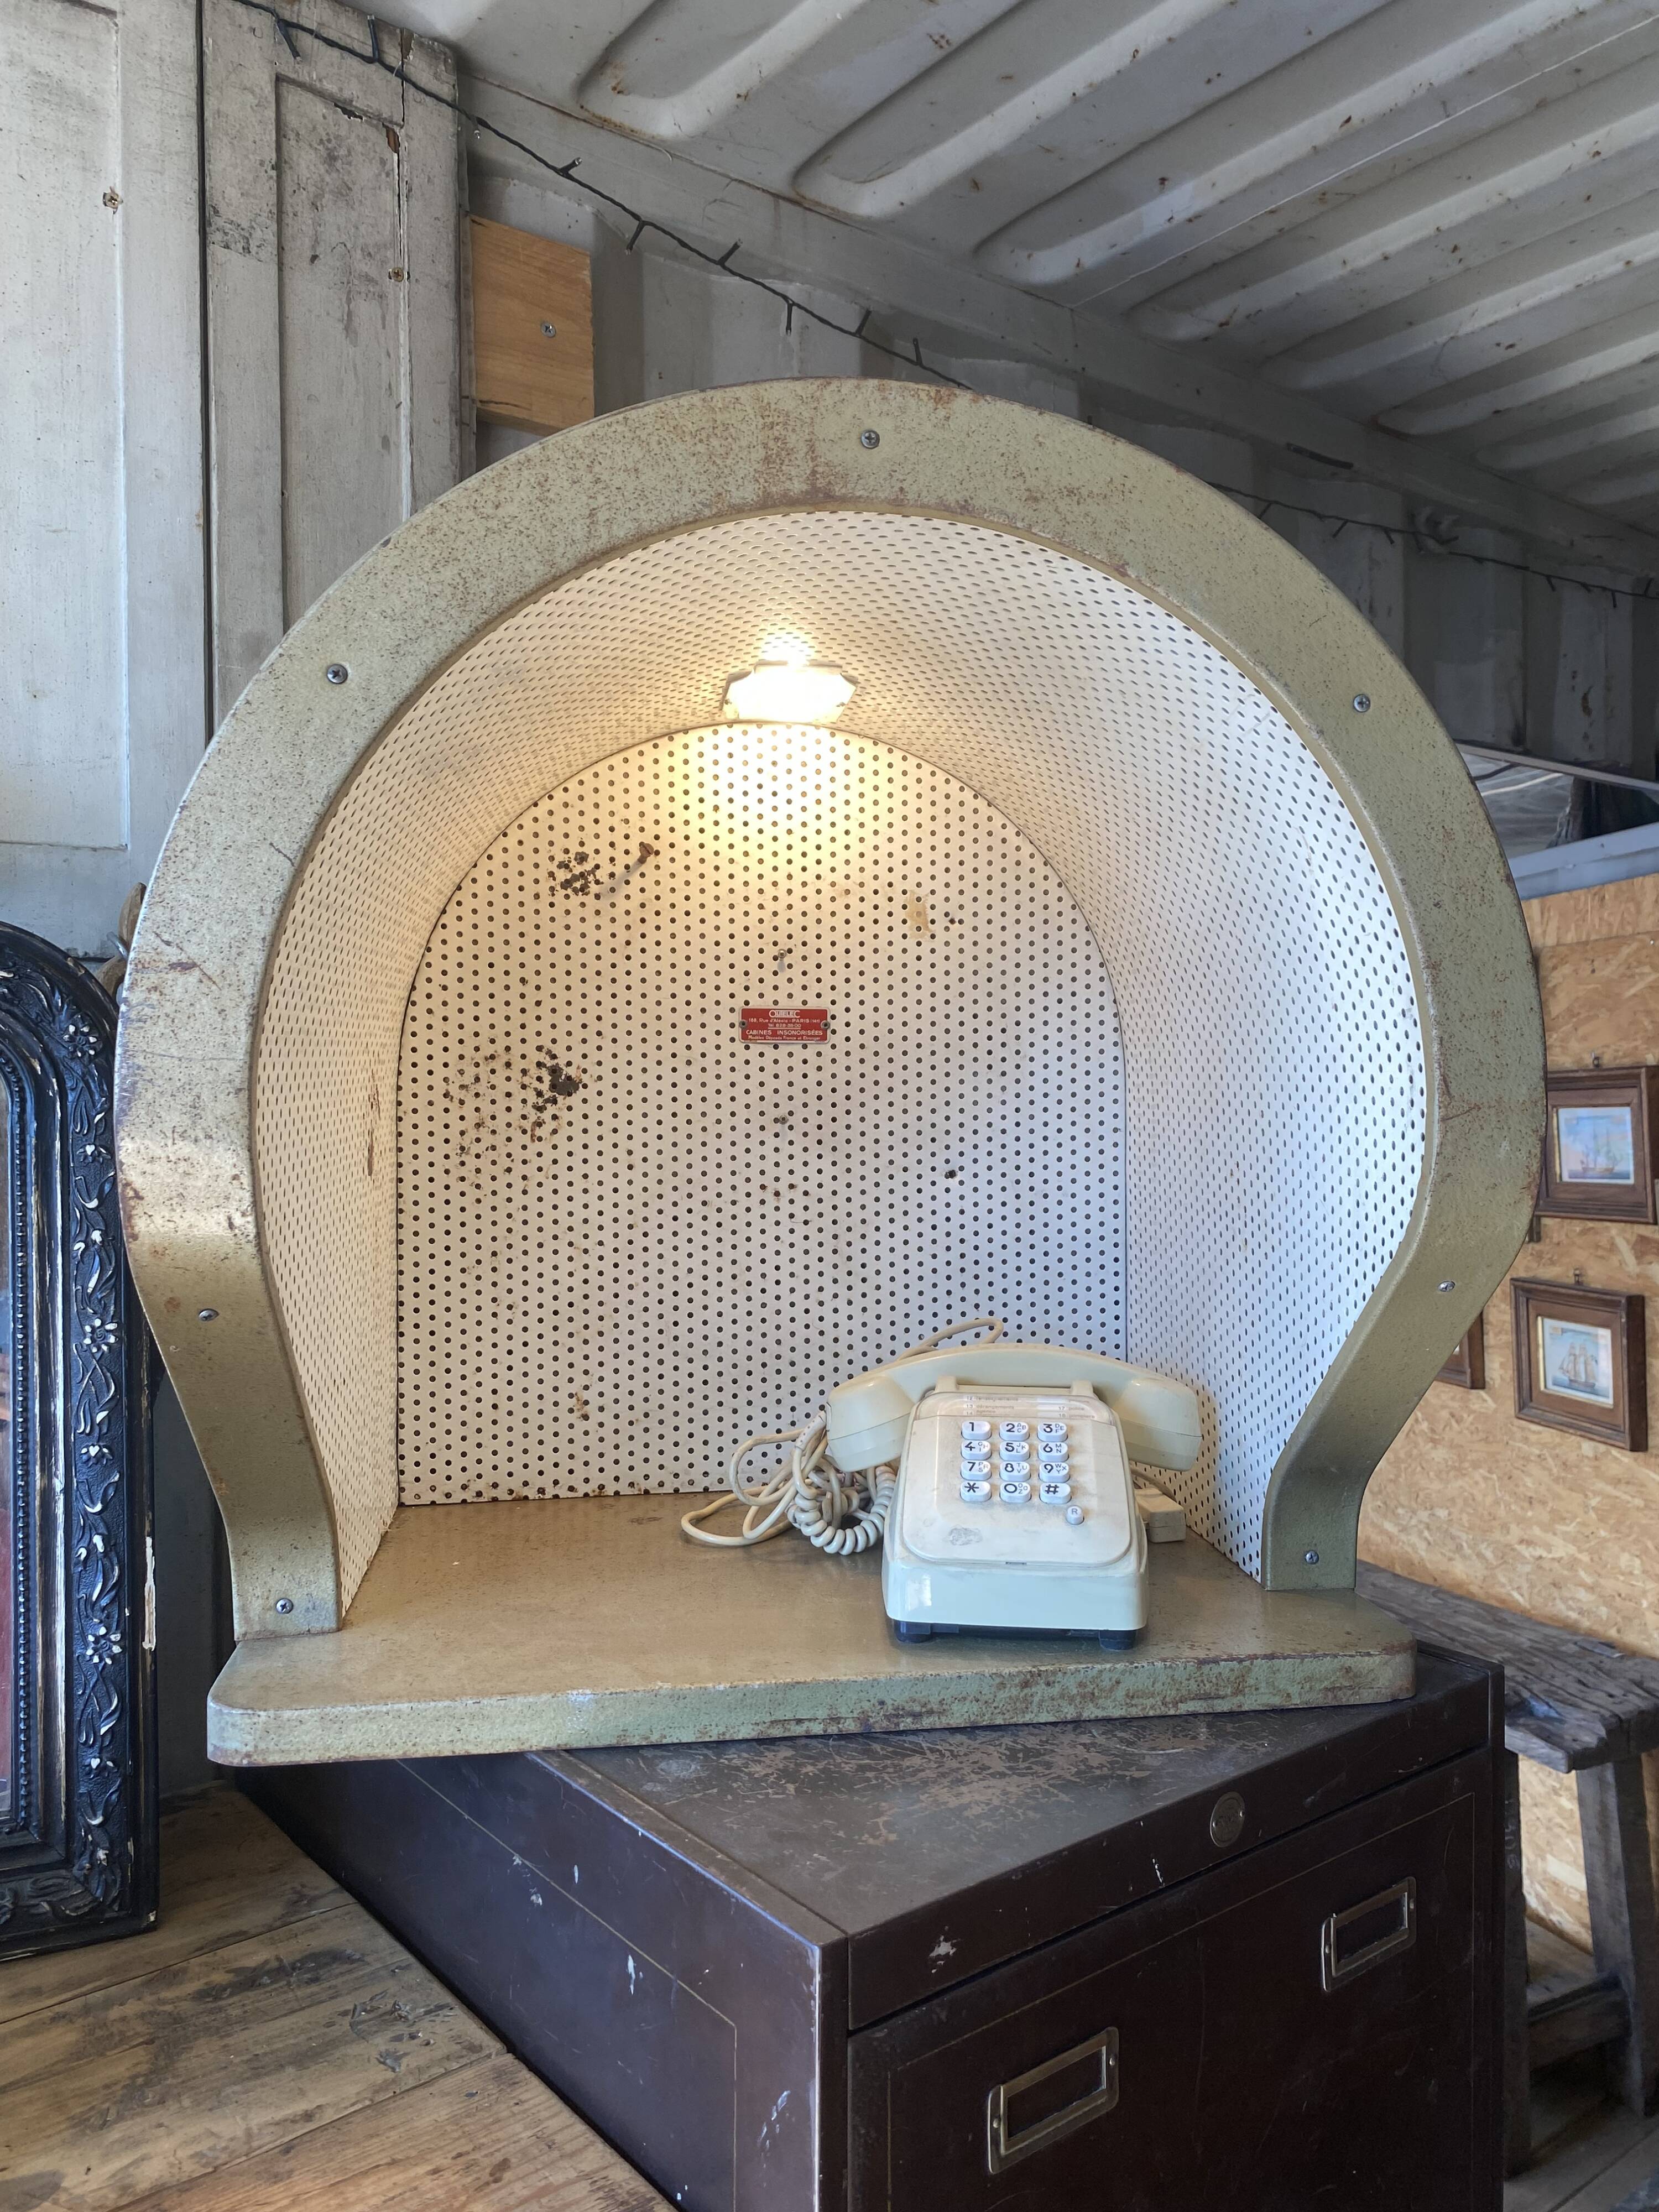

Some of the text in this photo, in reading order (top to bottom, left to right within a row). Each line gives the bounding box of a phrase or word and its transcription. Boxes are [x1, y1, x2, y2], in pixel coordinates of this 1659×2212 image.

[969, 1422, 974, 1431] 1
[1006, 1423, 1015, 1433] 2
[1044, 1423, 1052, 1433] 3
[964, 1441, 975, 1451] 4
[1005, 1443, 1014, 1452] 5
[1044, 1443, 1053, 1453] 6
[967, 1462, 975, 1471] 7
[1005, 1463, 1014, 1473] 8
[1044, 1463, 1053, 1473] 9
